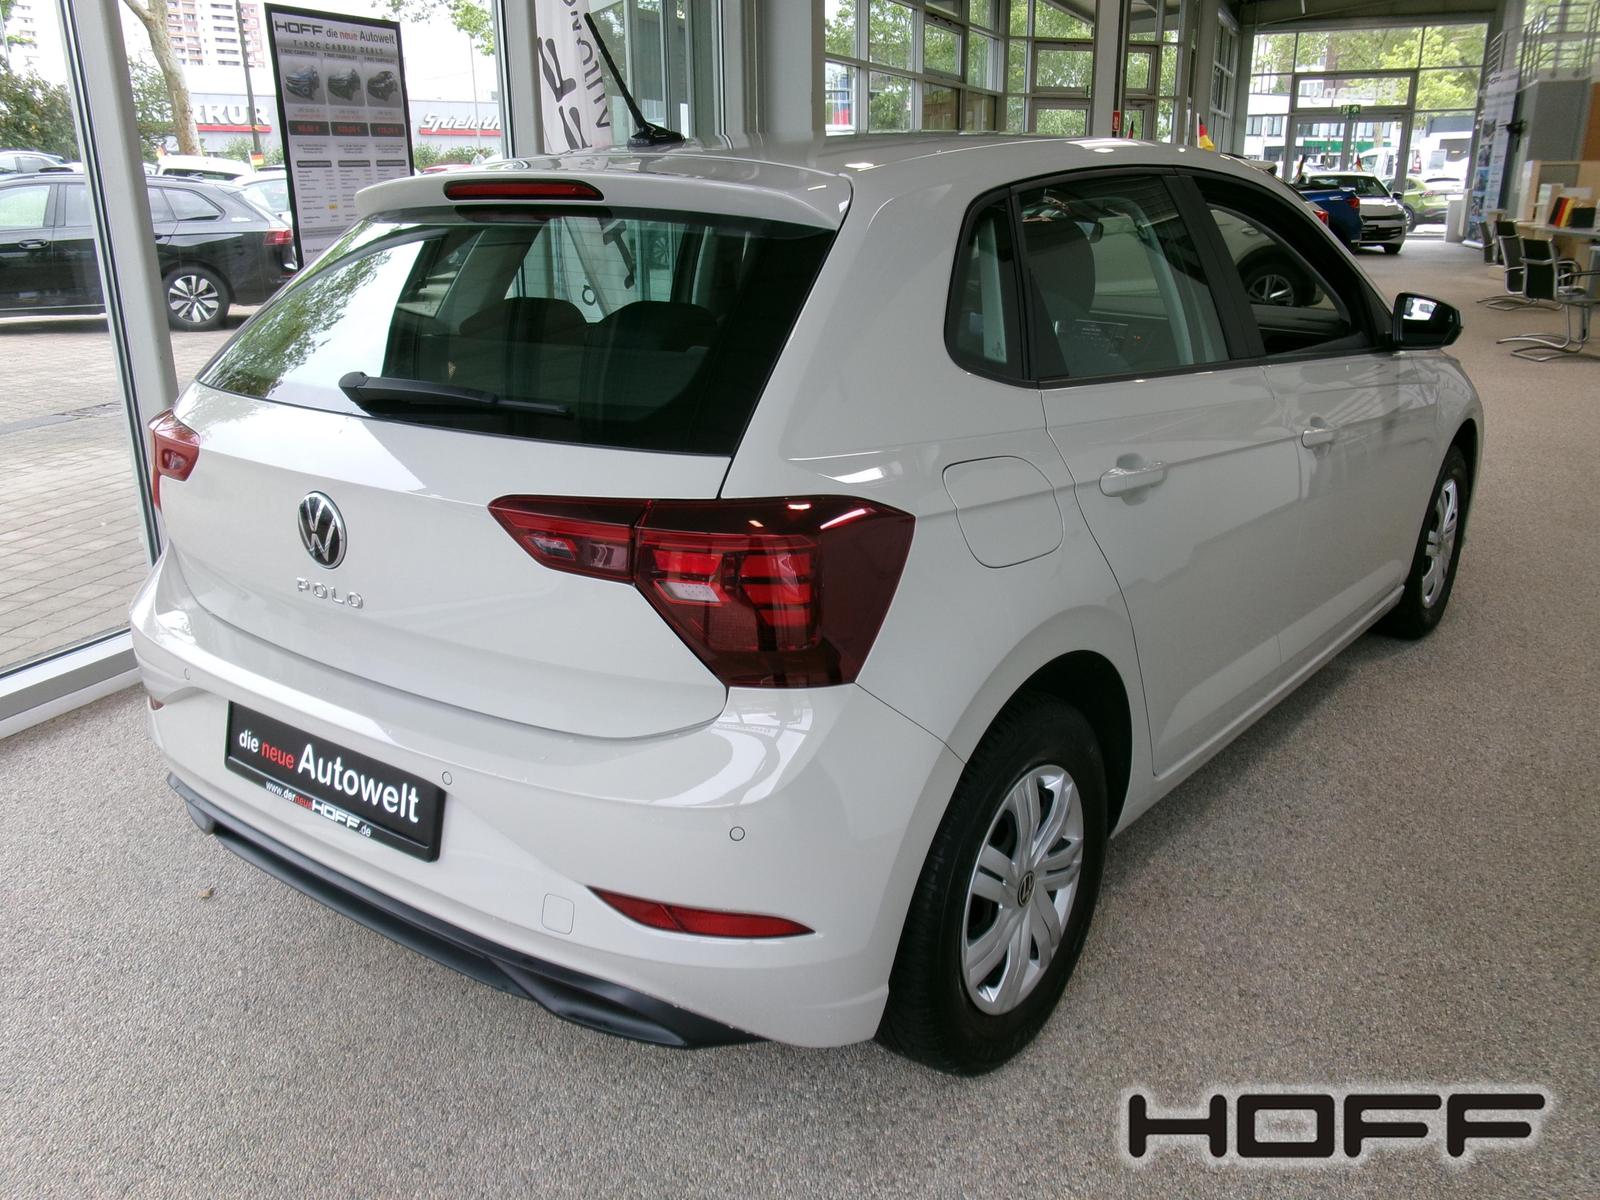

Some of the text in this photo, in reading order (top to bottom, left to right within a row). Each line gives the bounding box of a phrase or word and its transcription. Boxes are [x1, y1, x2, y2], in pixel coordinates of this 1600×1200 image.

[275, 21, 395, 44] HOFF die neue Autowelt
[293, 40, 321, 49] T-ROC
[297, 576, 363, 609] POLO
[239, 729, 419, 823] die neue Autowelt
[265, 780, 371, 837] www.derneueHOFF.de
